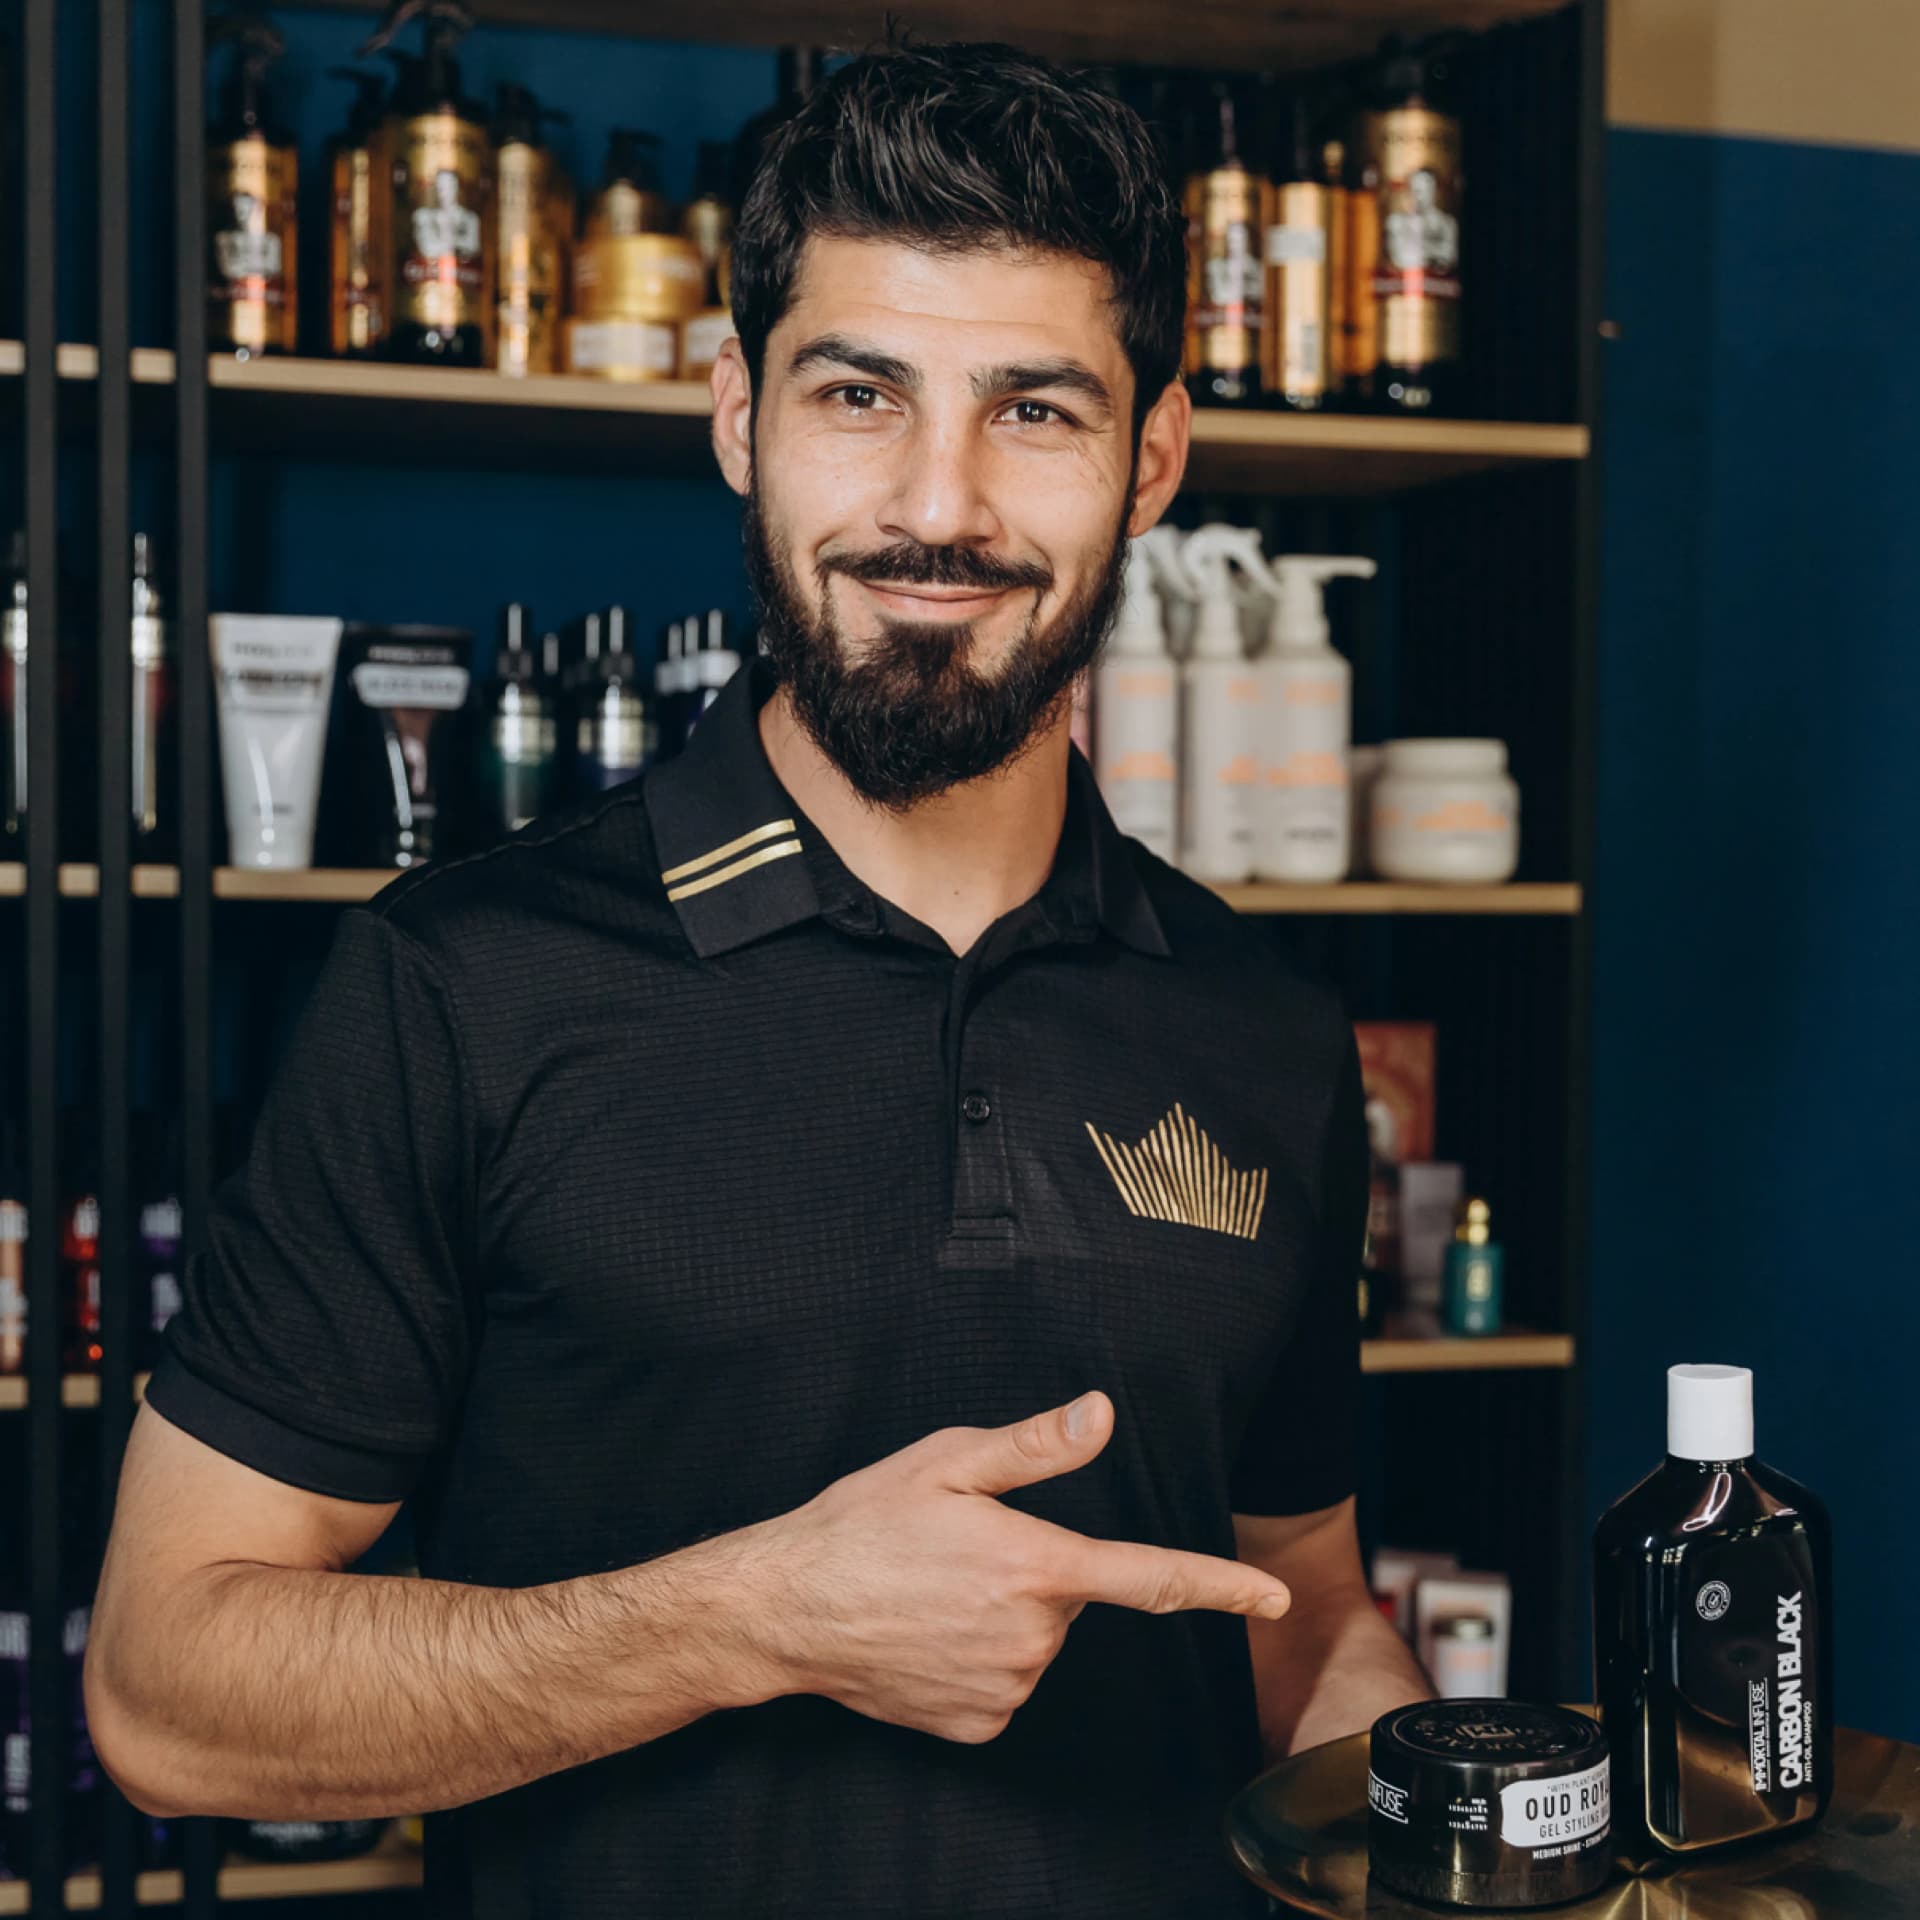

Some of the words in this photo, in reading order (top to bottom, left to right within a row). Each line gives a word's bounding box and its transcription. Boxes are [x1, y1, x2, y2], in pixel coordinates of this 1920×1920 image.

[1776, 1591, 1802, 1678] BLACK
[1752, 1682, 1765, 1726] INFUSE
[1803, 1701, 1813, 1744] SHAMPOO
[1778, 1680, 1803, 1789] CARBON
[1753, 1727, 1767, 1791] IMMORTAL
[1803, 1745, 1813, 1783] ANTI-OIL
[1525, 1793, 1571, 1821] OUD
[1539, 1823, 1560, 1838] GEL
[1564, 1810, 1600, 1834] STYLING
